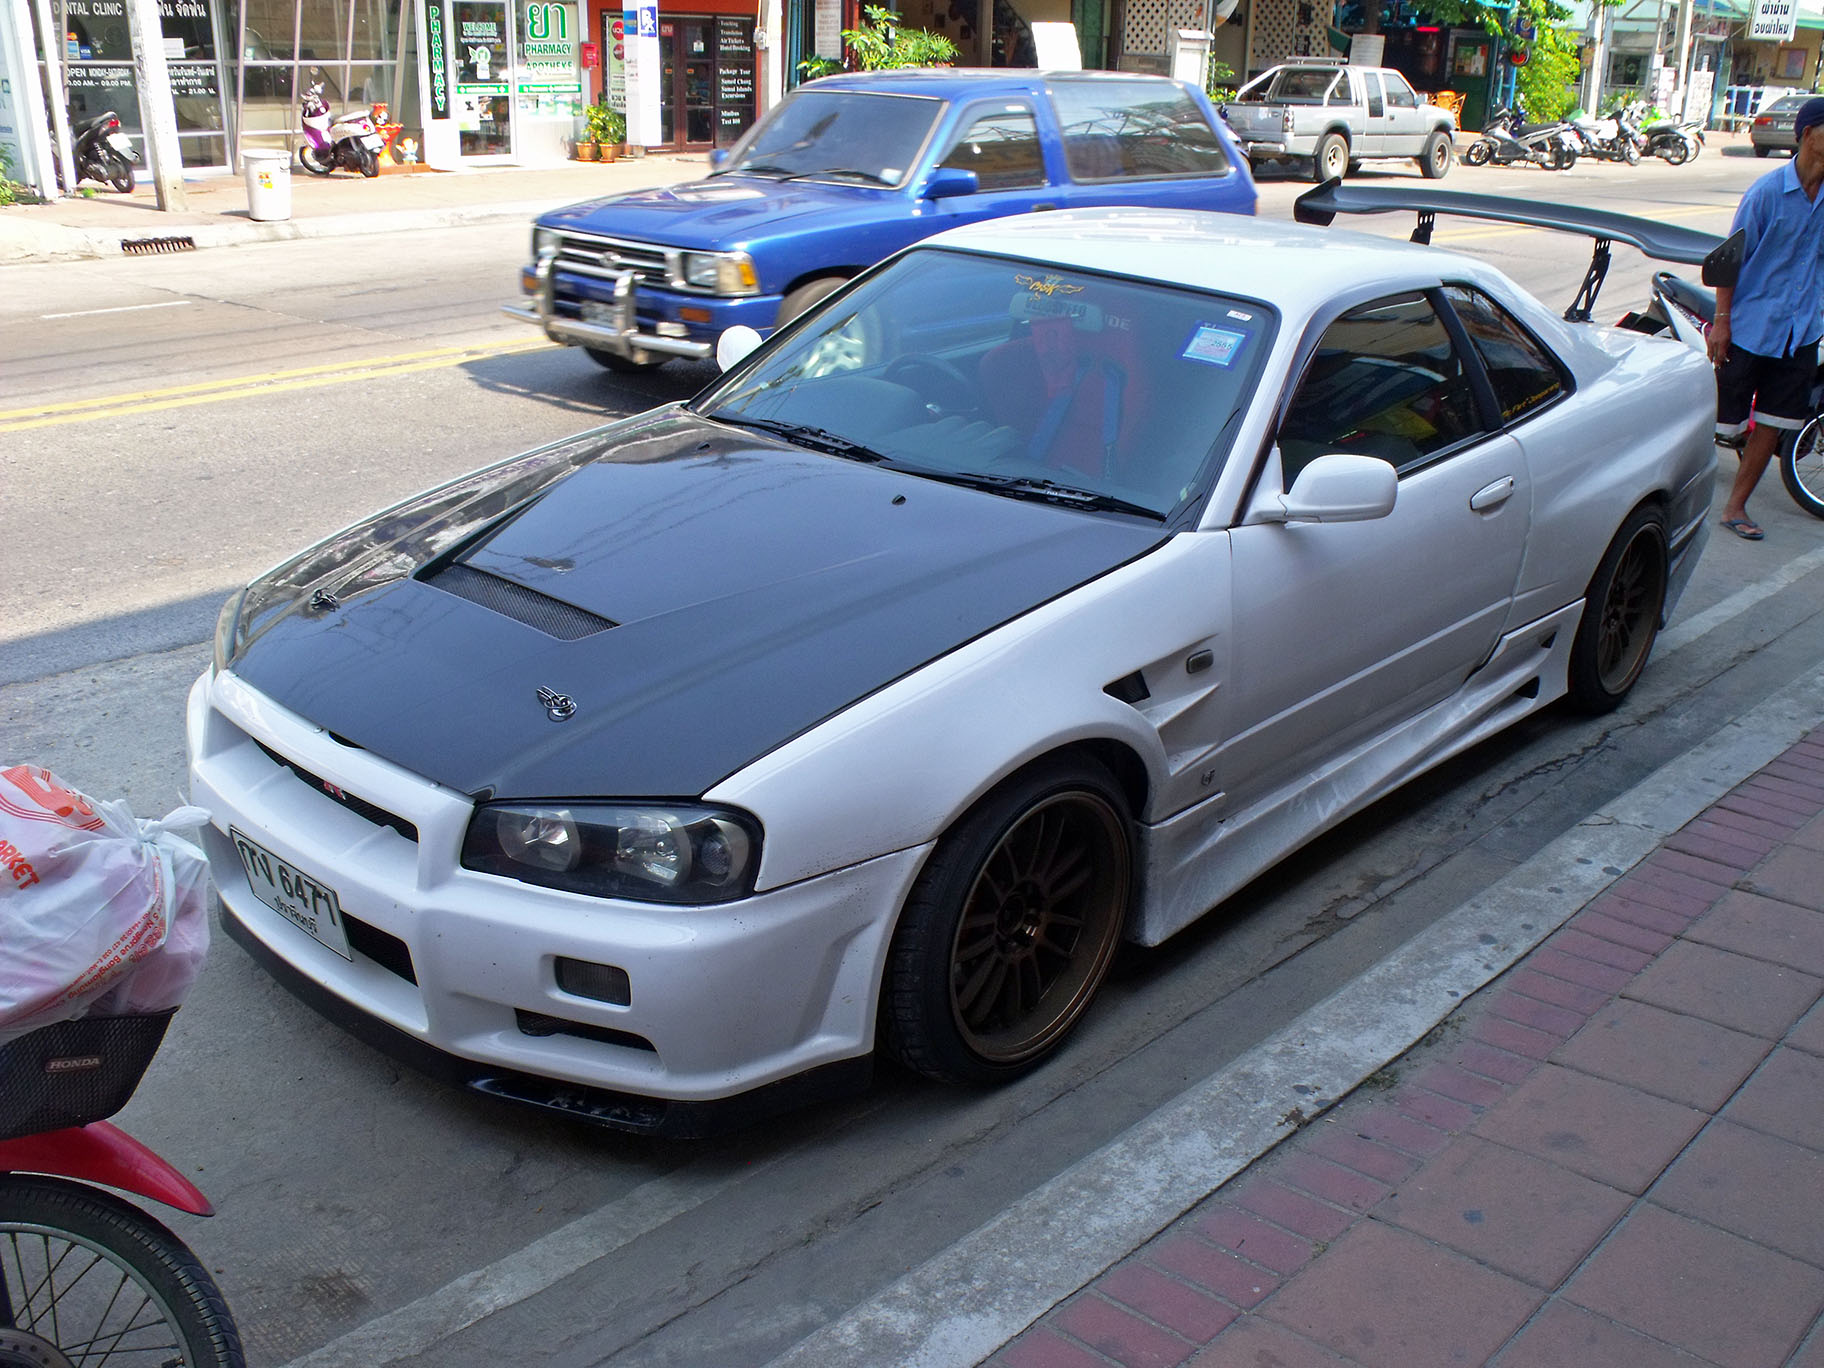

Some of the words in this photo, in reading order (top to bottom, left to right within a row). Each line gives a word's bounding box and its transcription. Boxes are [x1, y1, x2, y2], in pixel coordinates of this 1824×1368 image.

[53, 2, 90, 15] DNTAL
[92, 2, 123, 16] CLINIC
[527, 3, 567, 40] ยา
[462, 22, 497, 32] WELCOME
[429, 6, 446, 111] PHARMACY
[525, 43, 572, 55] PHARMACY
[278, 864, 337, 927] 6471
[120, 919, 155, 956] Nongprue
[49, 1057, 100, 1070] HONDA
